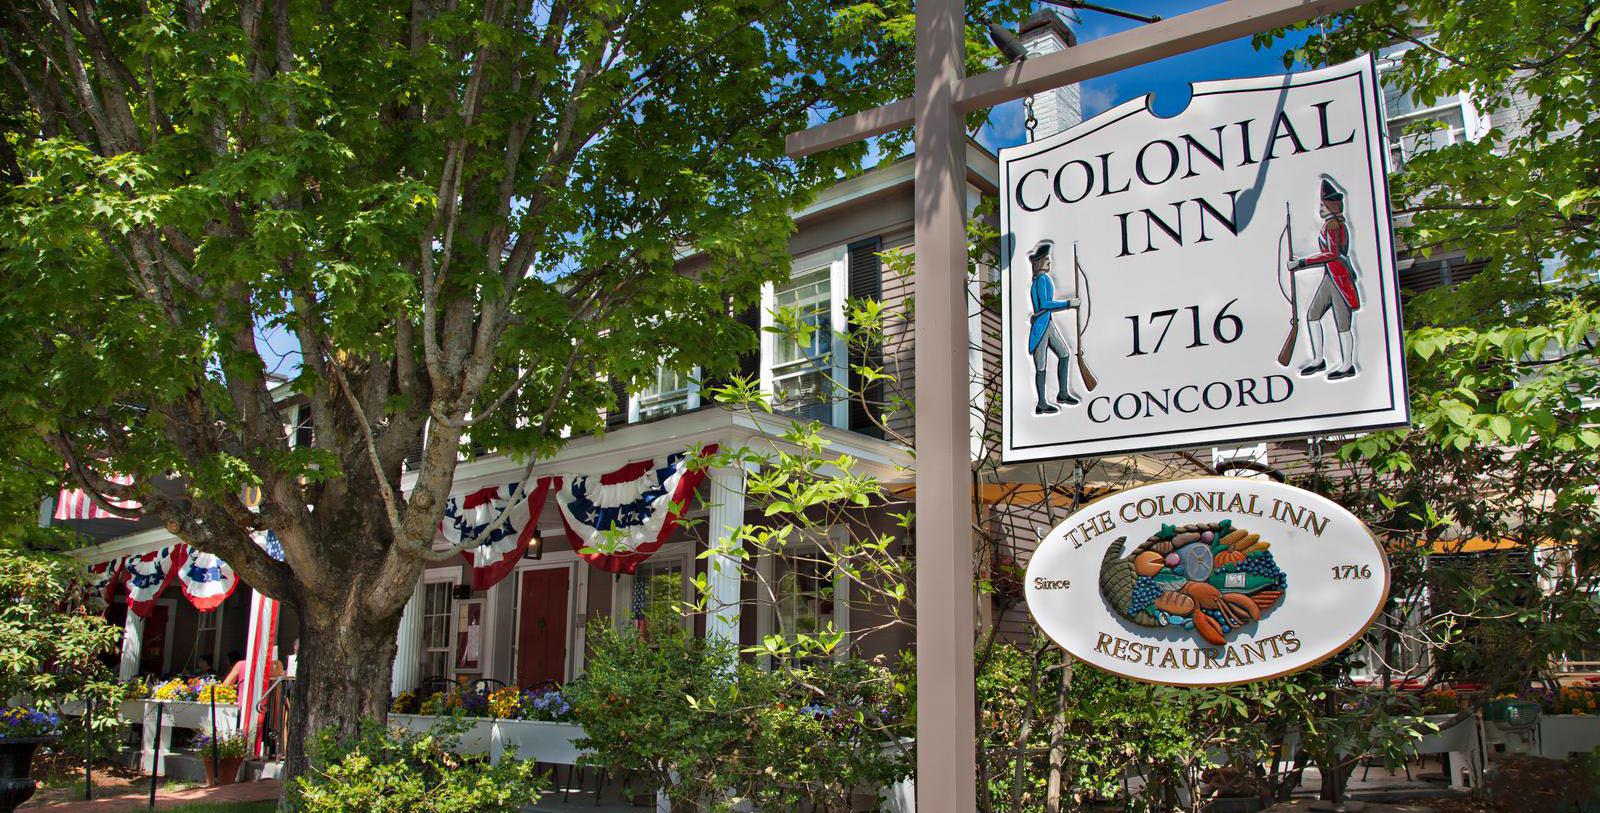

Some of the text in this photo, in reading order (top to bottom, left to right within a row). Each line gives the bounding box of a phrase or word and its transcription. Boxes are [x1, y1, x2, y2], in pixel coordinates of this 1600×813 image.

[1016, 100, 1356, 212] COLONIAL
[1115, 190, 1242, 257] INN
[1125, 298, 1243, 357] 1716
[1087, 374, 1293, 422] CONCORD
[1063, 491, 1331, 549] THE COLONIAL INN
[1034, 577, 1071, 590] Since
[1332, 565, 1372, 580] 1716
[1095, 630, 1301, 669] RESTAURANTS
